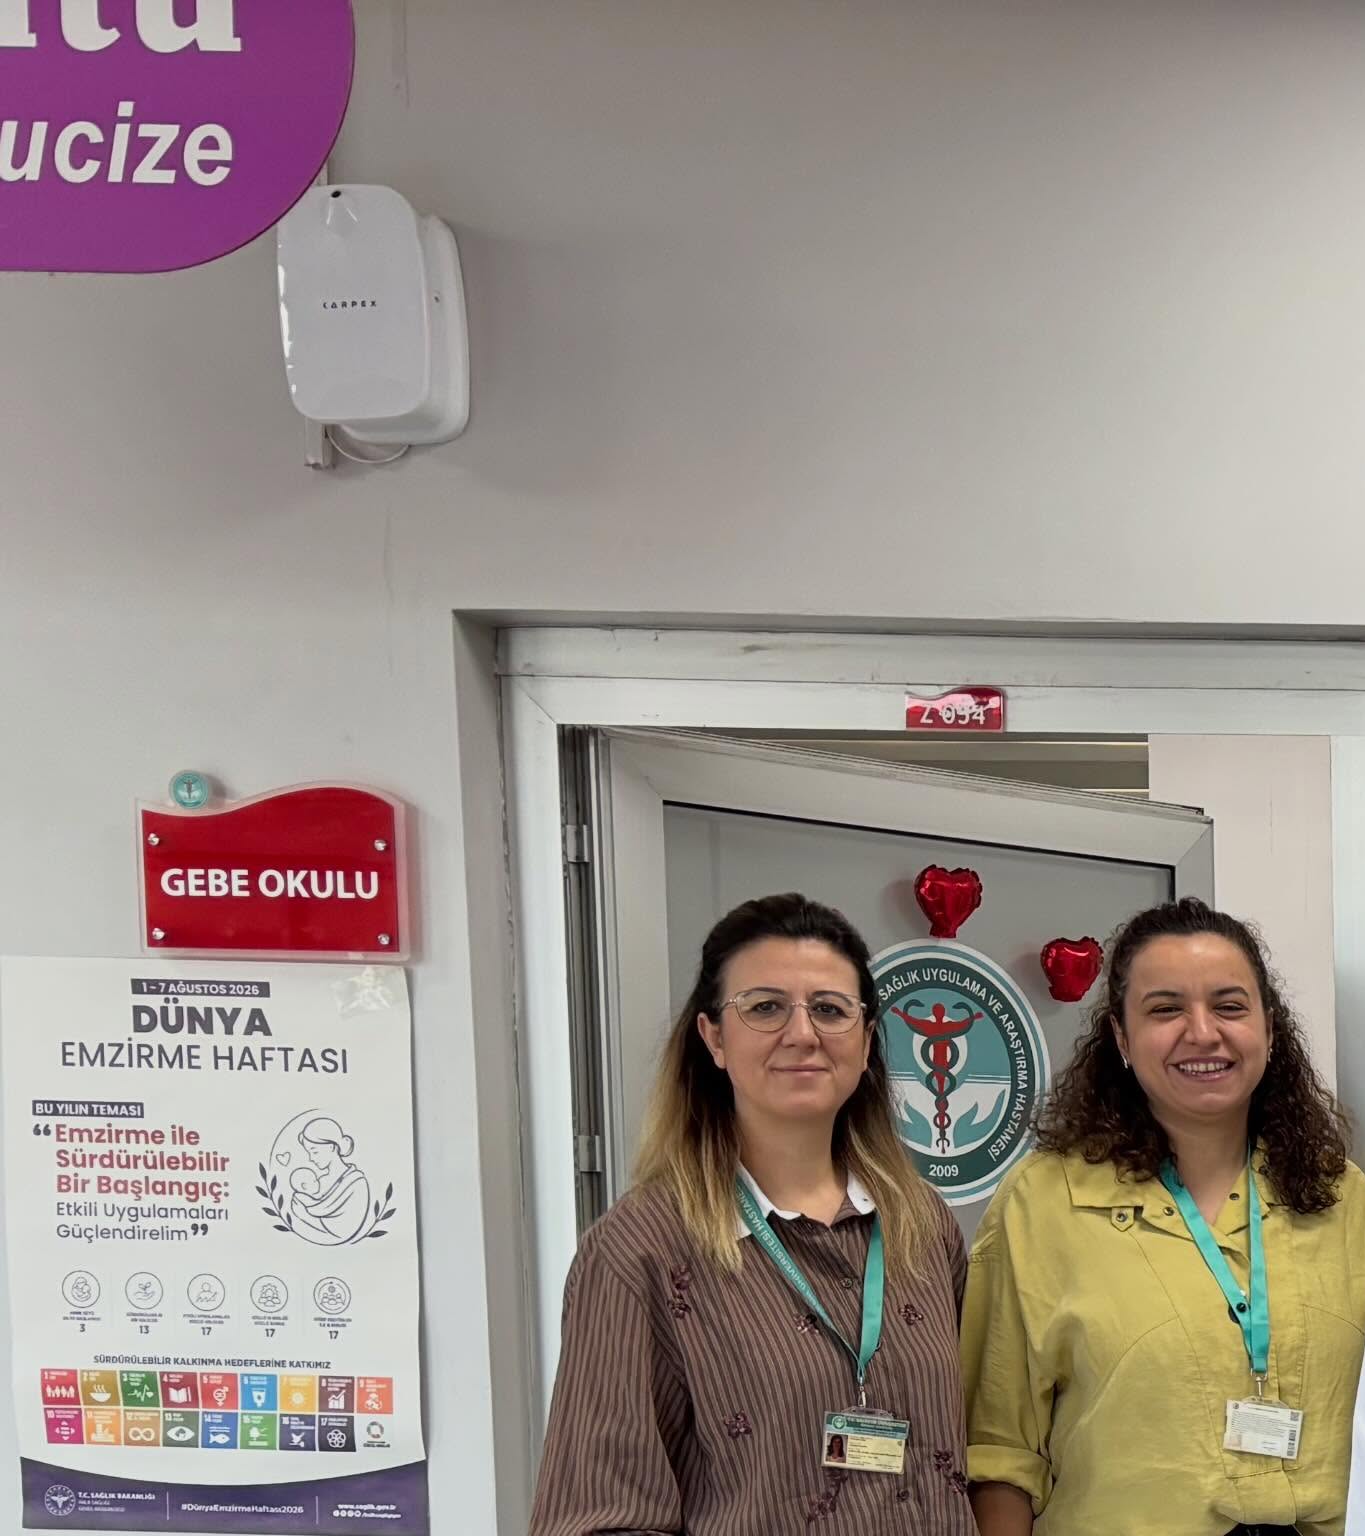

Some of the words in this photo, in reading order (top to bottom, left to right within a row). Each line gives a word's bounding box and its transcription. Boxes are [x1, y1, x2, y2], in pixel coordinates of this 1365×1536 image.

[0, 101, 233, 187] ucize
[322, 300, 377, 309] CARPEX
[160, 868, 250, 897] GEBE
[258, 869, 379, 900] OKULU
[168, 981, 227, 994] AĞUSTOS
[229, 984, 260, 995] 2026
[132, 996, 273, 1037] DÜNYA
[878, 969, 920, 1001] SAĞLIK
[922, 967, 986, 1001] UYGULAMA
[987, 994, 1003, 1014] VE
[999, 1013, 1028, 1090] ARAŞTIRMA
[61, 1036, 201, 1070] EMZİRME
[213, 1045, 349, 1074] HAFTASI
[35, 1103, 53, 1114] BU
[56, 1104, 89, 1115] YILIN
[91, 1104, 142, 1117] TEMASI
[171, 1124, 200, 1146] ile
[56, 1148, 230, 1172] Sürdürülebilir
[928, 1164, 959, 1177] 2009
[57, 1173, 90, 1194] Bir
[97, 1175, 230, 1204] Başlangıç:
[57, 1201, 98, 1217] Etkili
[103, 1203, 229, 1222] Uygulamaları
[79, 1323, 86, 1333] 3
[139, 1325, 150, 1335] 13
[201, 1326, 212, 1337] 17
[265, 1328, 276, 1338] 17
[328, 1330, 339, 1340] 17
[93, 1354, 171, 1366] SÜRDÜRÜLEBİLİR
[174, 1357, 222, 1367] KALKINMA
[224, 1356, 287, 1368] HEDEFLERİNE
[289, 1359, 331, 1370] KATKIMIZ
